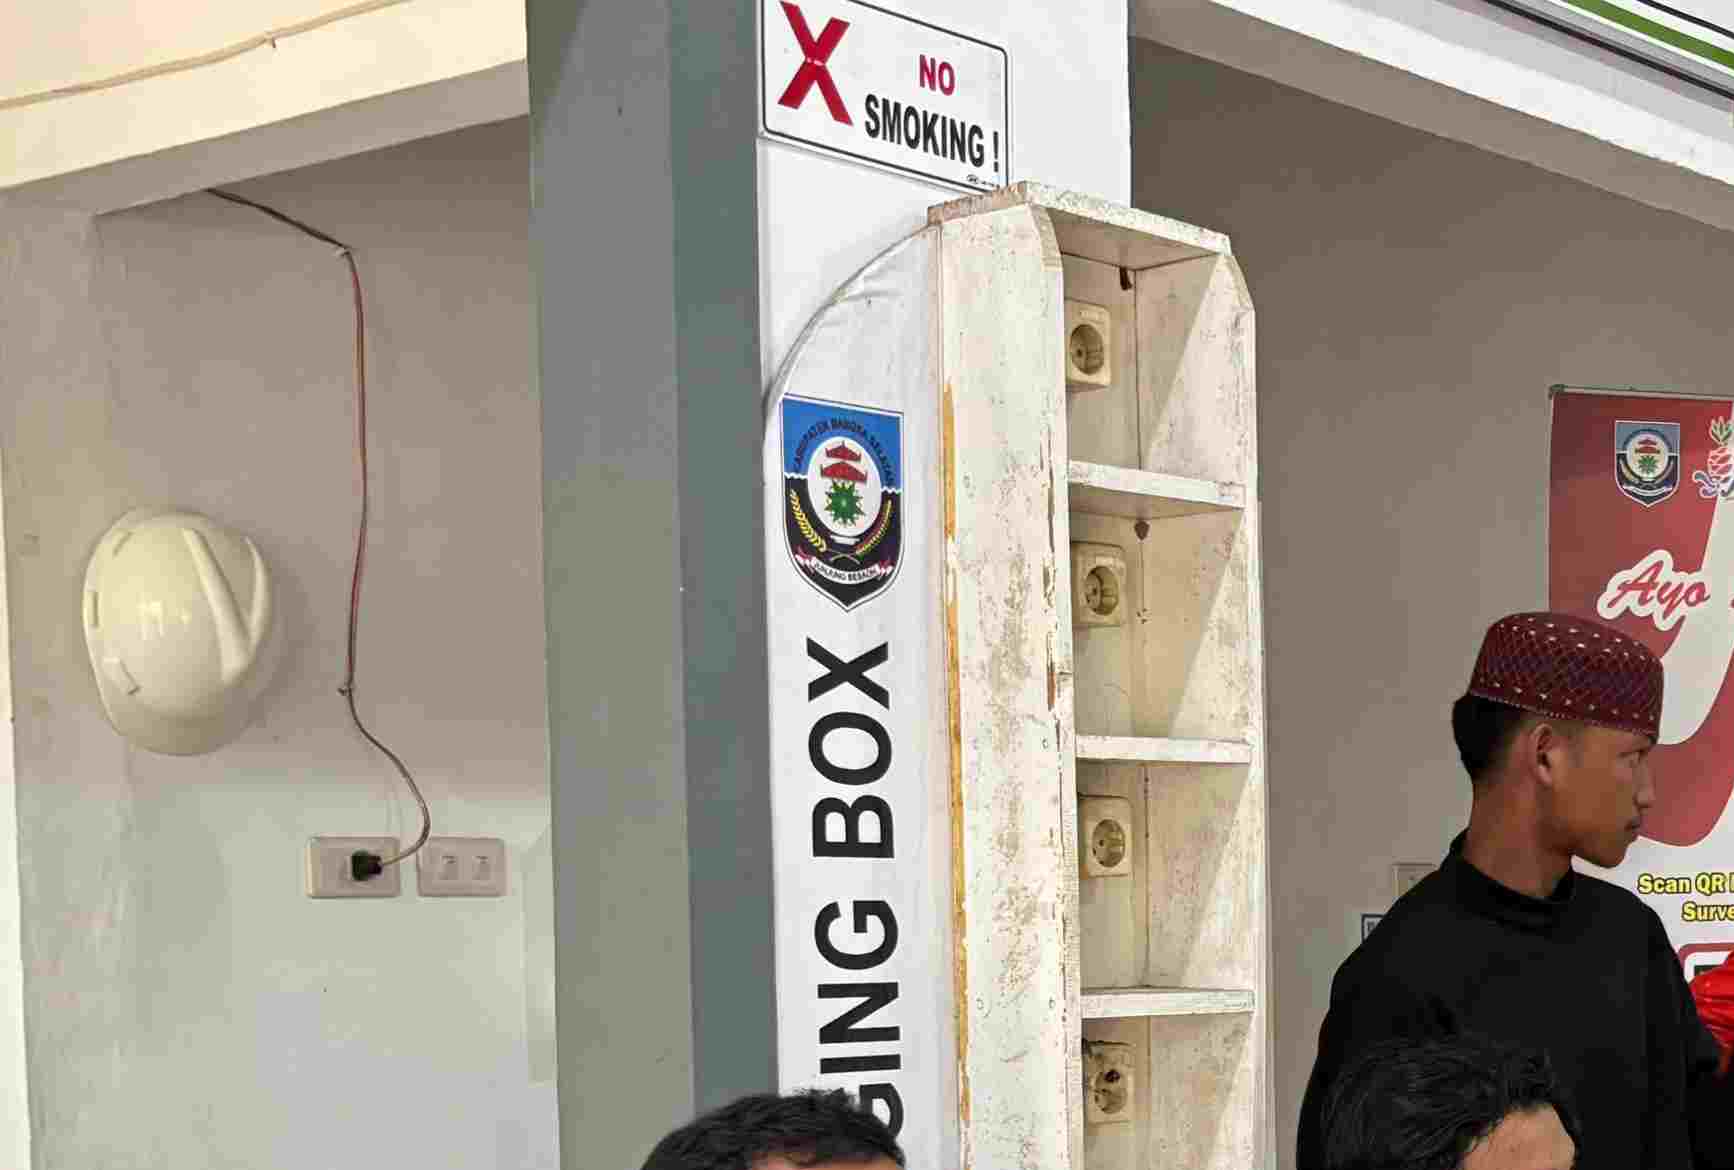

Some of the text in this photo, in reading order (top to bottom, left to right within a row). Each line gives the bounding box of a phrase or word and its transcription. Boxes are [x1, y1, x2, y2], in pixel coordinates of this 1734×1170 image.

[919, 53, 956, 96] NO
[1606, 559, 1710, 619] Ayo
[806, 636, 896, 859] BOX
[1638, 874, 1690, 894] Scan
[1695, 872, 1725, 896] QR
